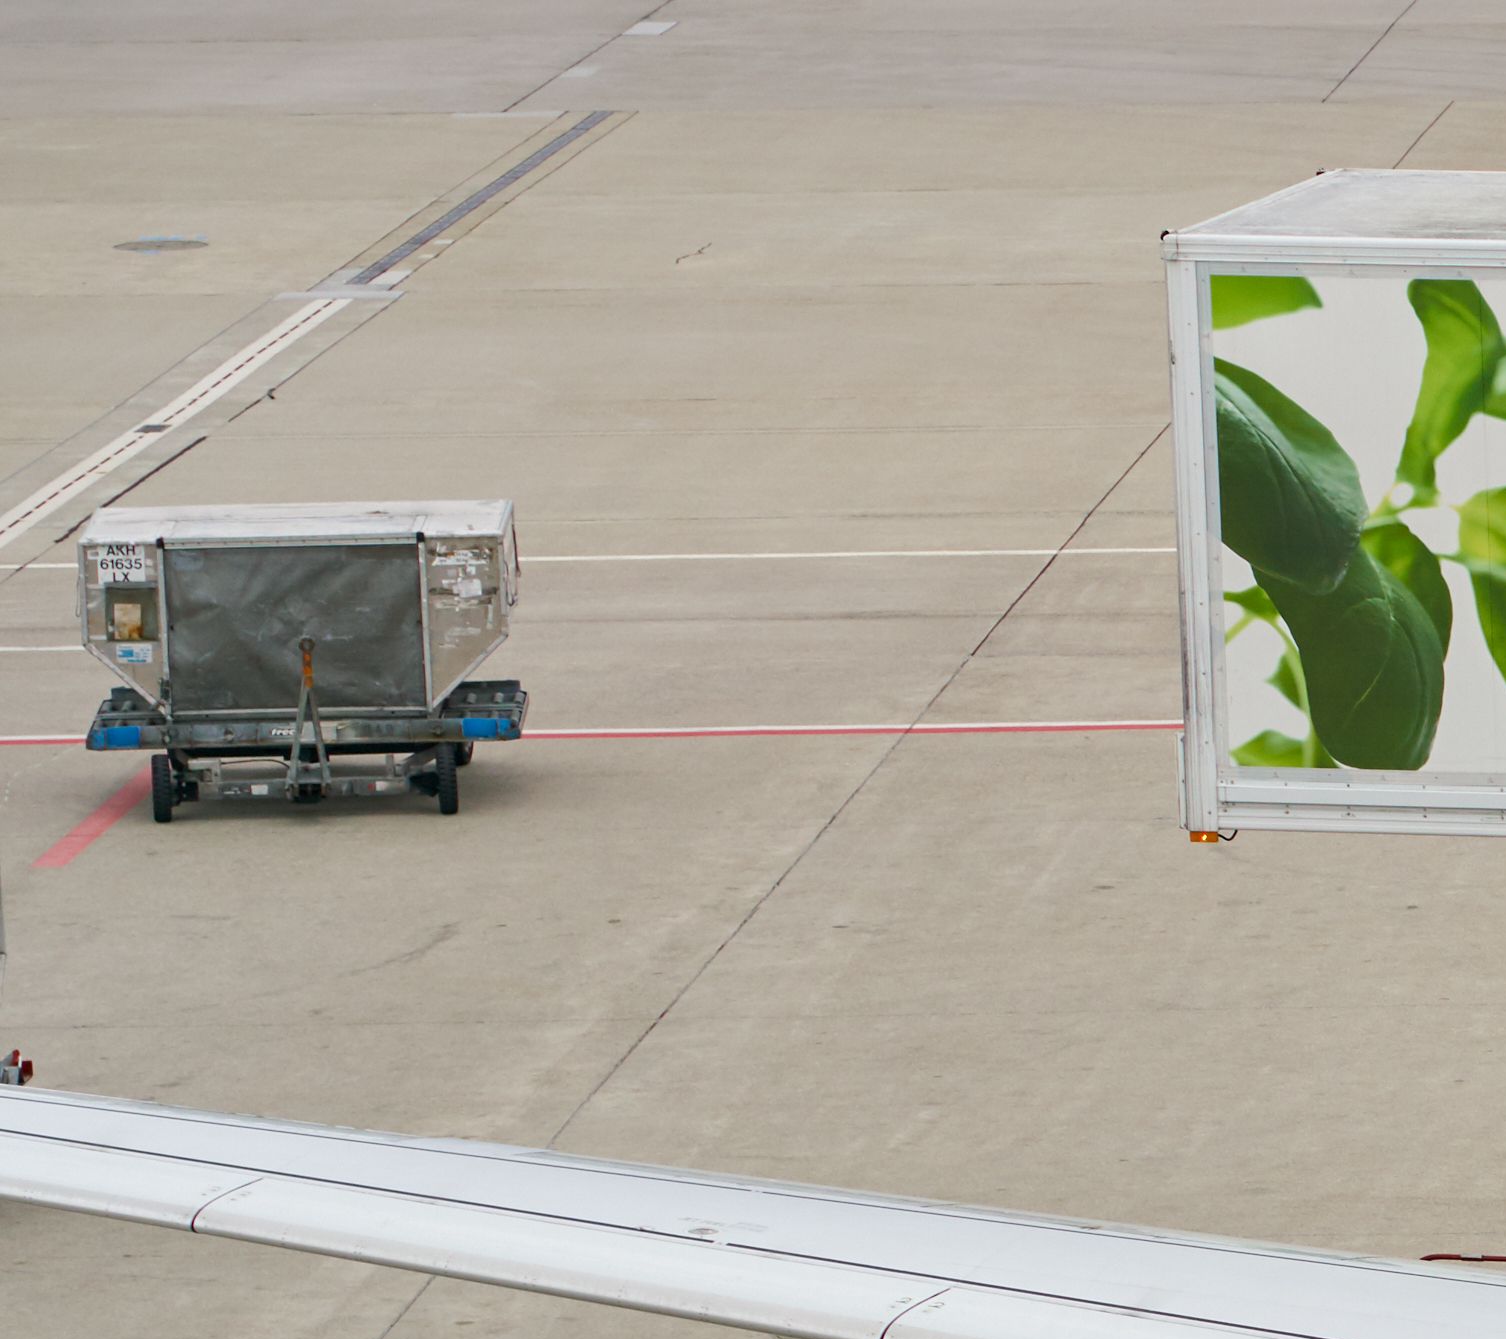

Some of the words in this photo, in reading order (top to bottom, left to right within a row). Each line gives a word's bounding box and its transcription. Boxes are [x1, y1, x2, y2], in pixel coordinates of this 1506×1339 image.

[106, 545, 136, 556] AKH
[100, 559, 142, 570] 61635
[112, 572, 130, 583] LX
